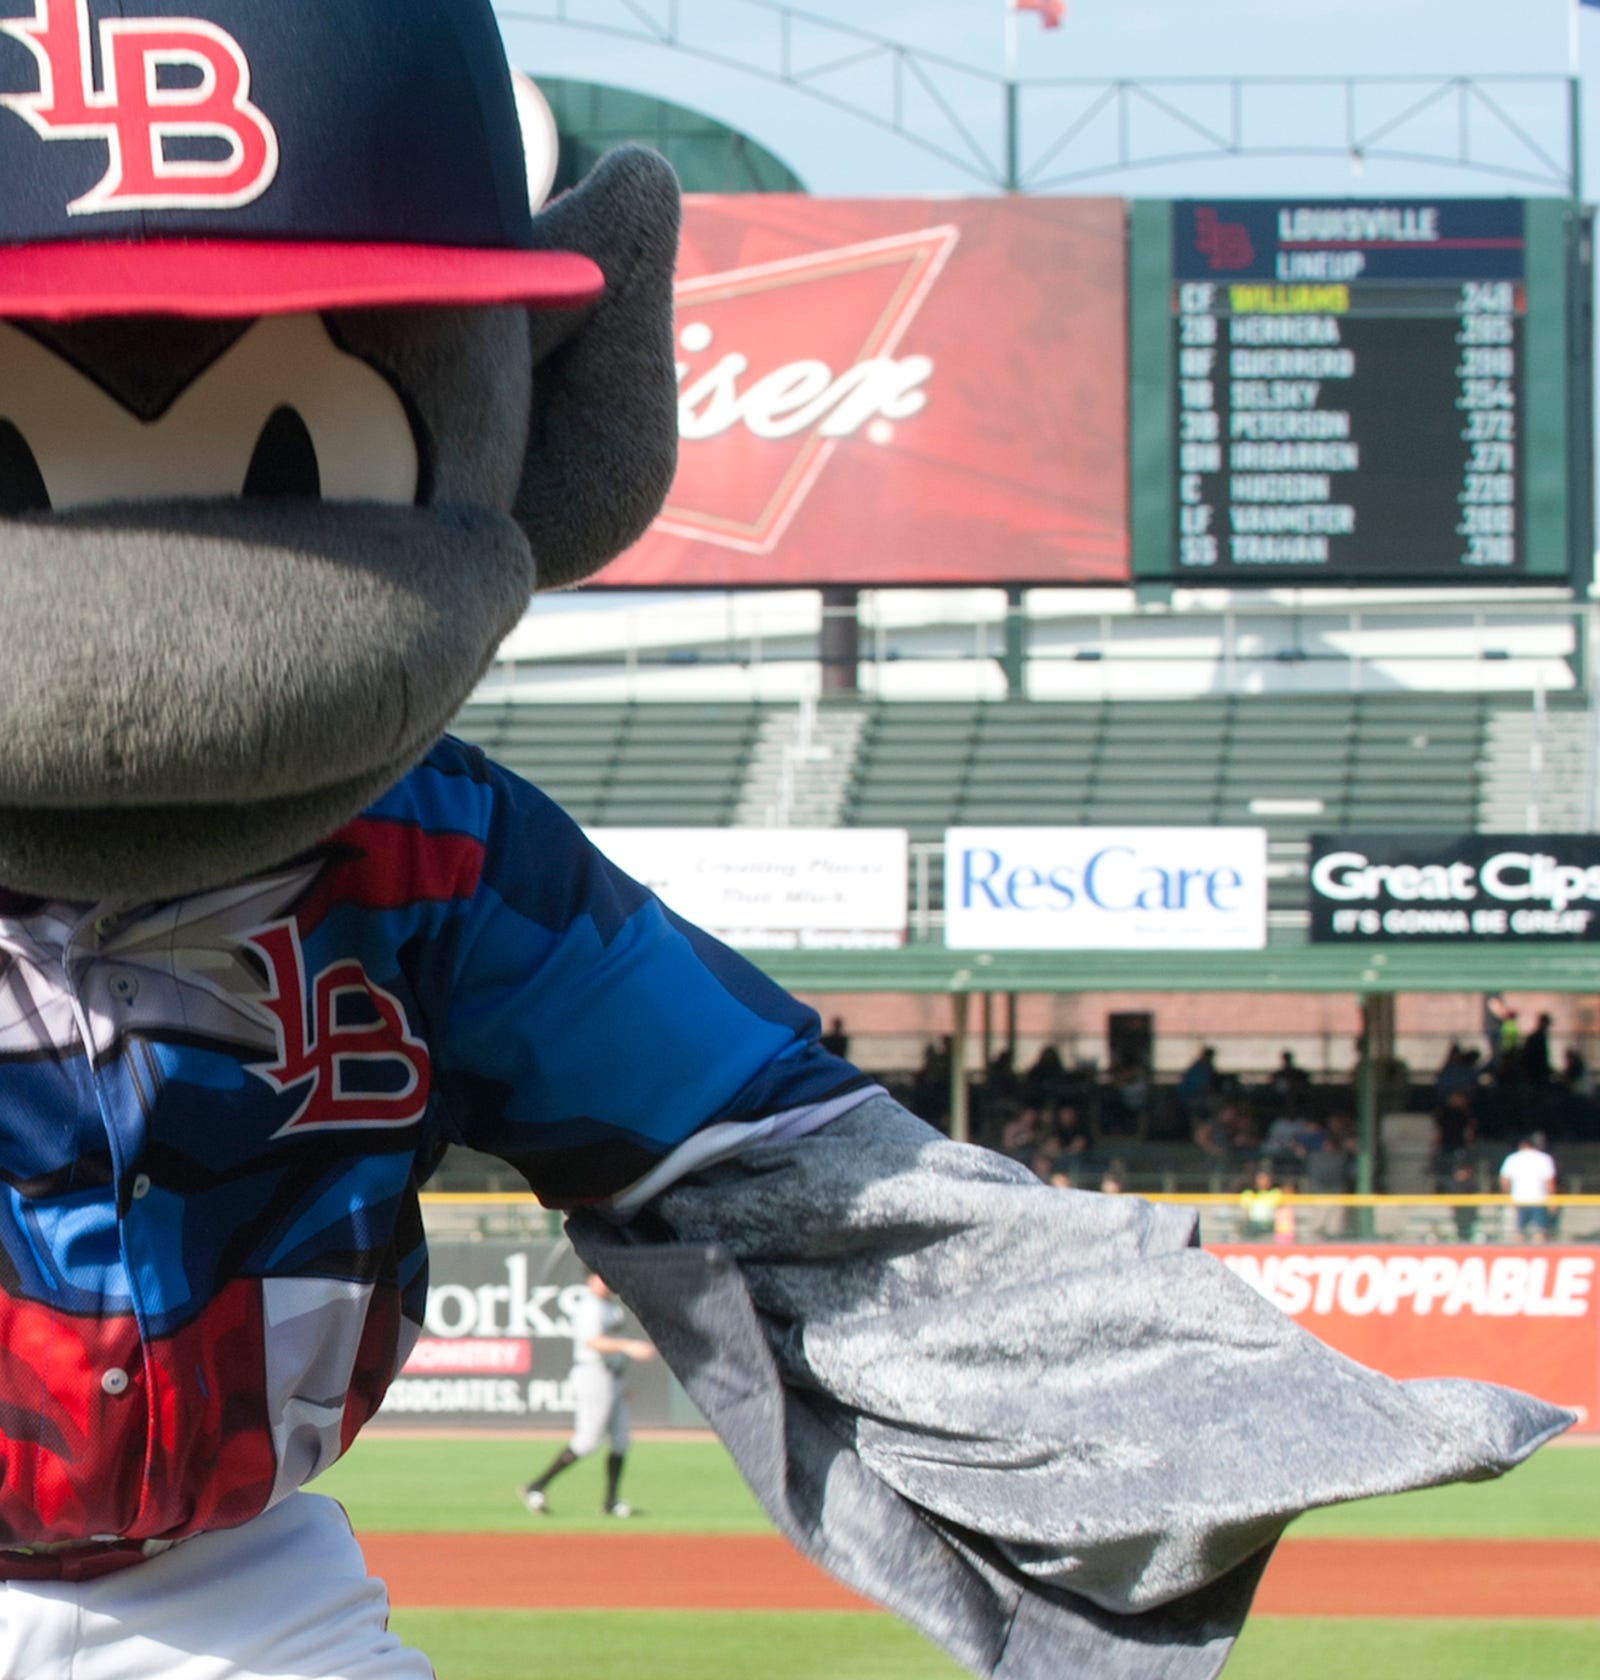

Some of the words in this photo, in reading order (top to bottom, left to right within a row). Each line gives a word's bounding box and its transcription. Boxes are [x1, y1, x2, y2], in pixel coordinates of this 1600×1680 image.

[1277, 208, 1440, 242] LOUISVILLE
[1276, 251, 1366, 282] LINEUP
[1179, 282, 1215, 314] CF
[1229, 283, 1349, 314] WILLIAMS
[675, 321, 934, 440] iser
[1179, 473, 1201, 504] C
[1179, 505, 1213, 534] LF
[961, 846, 1244, 912] ResCare
[1311, 851, 1477, 900] Great
[1332, 909, 1381, 934] IT'S
[1382, 909, 1470, 934] GONNA
[1472, 909, 1507, 934] BE
[238, 914, 431, 1140] LB
[423, 1252, 592, 1338] orks
